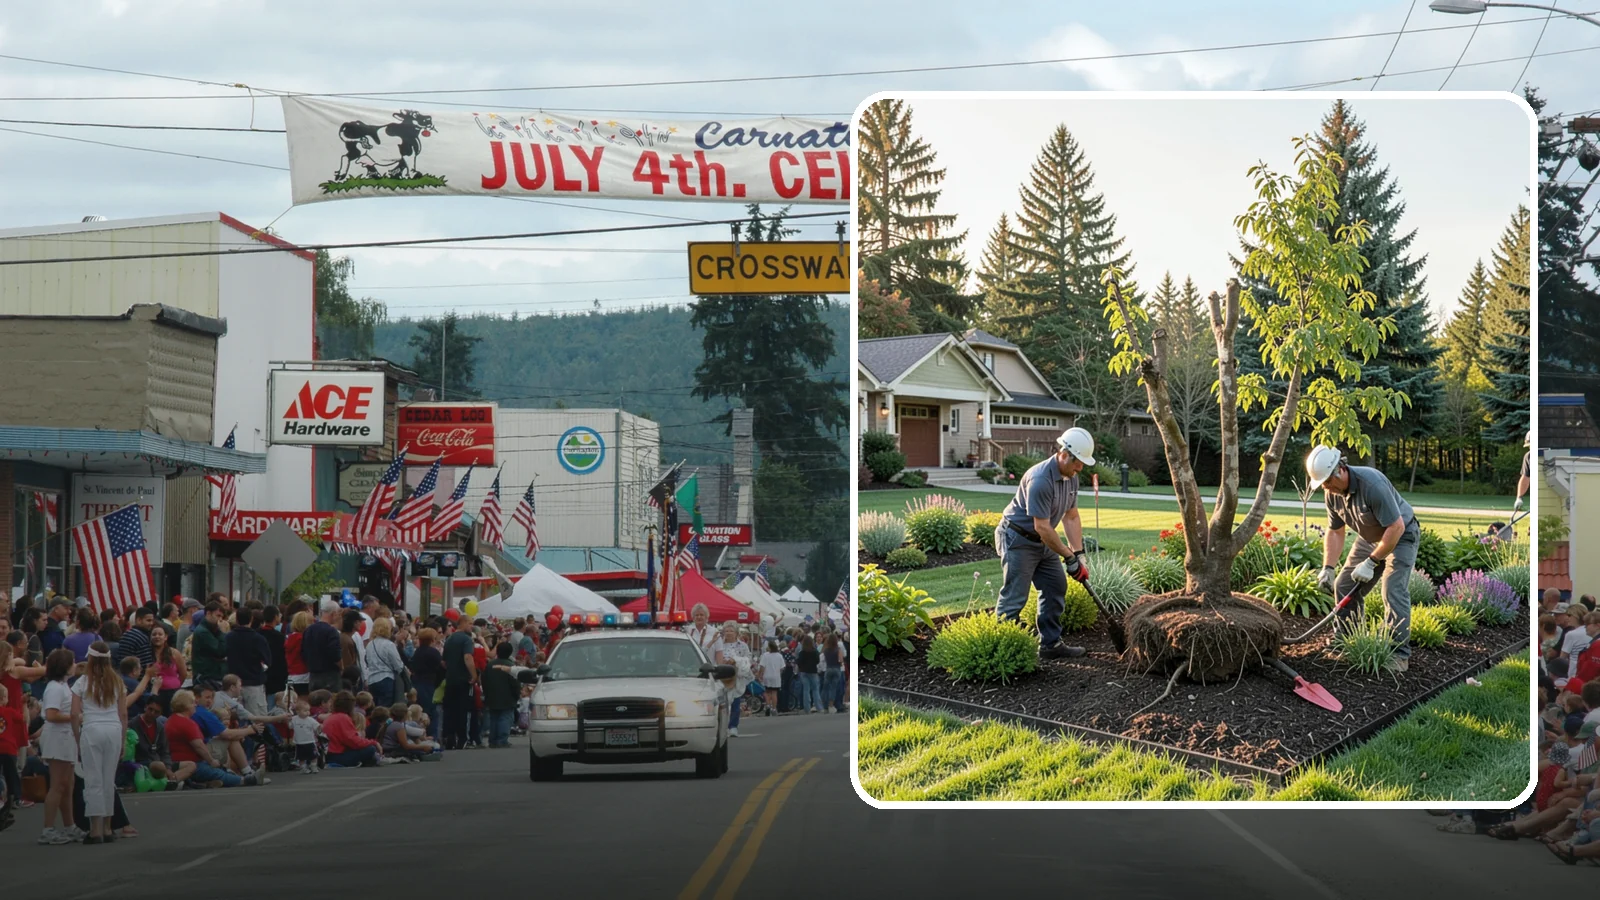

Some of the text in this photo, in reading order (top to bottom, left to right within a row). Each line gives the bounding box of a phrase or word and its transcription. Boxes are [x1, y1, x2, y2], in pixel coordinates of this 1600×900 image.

[695, 121, 850, 149] Carnat
[481, 141, 605, 193] JULY
[632, 150, 746, 198] 4th.
[697, 254, 850, 280] CROSSWA
[282, 380, 374, 420] ACE
[406, 410, 452, 422] CEDAR
[283, 421, 371, 437] Hardware
[83, 484, 155, 495] St. Vincent de Paul
[212, 516, 331, 536] HARDARE
[688, 526, 741, 535] CRNATION
[699, 535, 730, 543] GLASS
